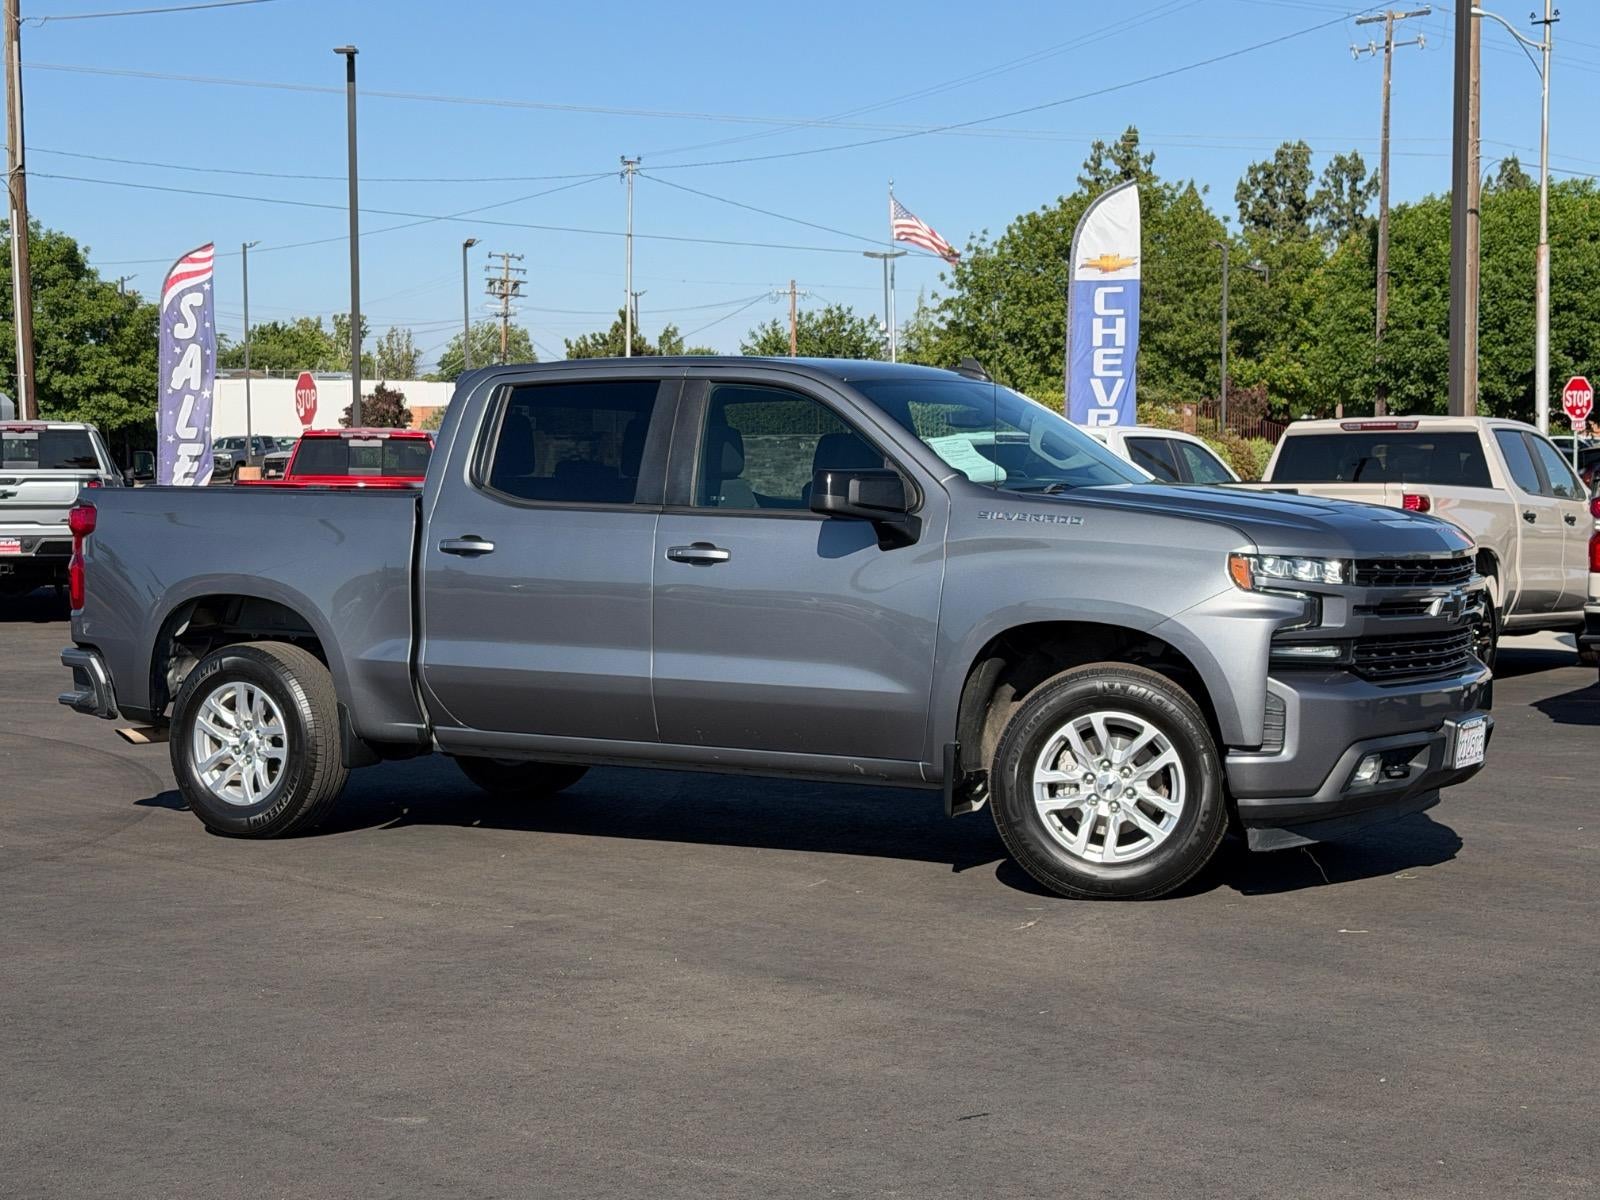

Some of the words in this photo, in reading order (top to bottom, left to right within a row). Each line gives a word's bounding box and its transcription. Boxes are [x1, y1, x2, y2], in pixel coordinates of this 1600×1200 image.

[171, 292, 204, 486] SALE
[297, 389, 316, 410] STOP
[1565, 390, 1591, 407] STOP
[976, 510, 1085, 526] SILVERADO
[249, 774, 299, 826] MICHELIN
